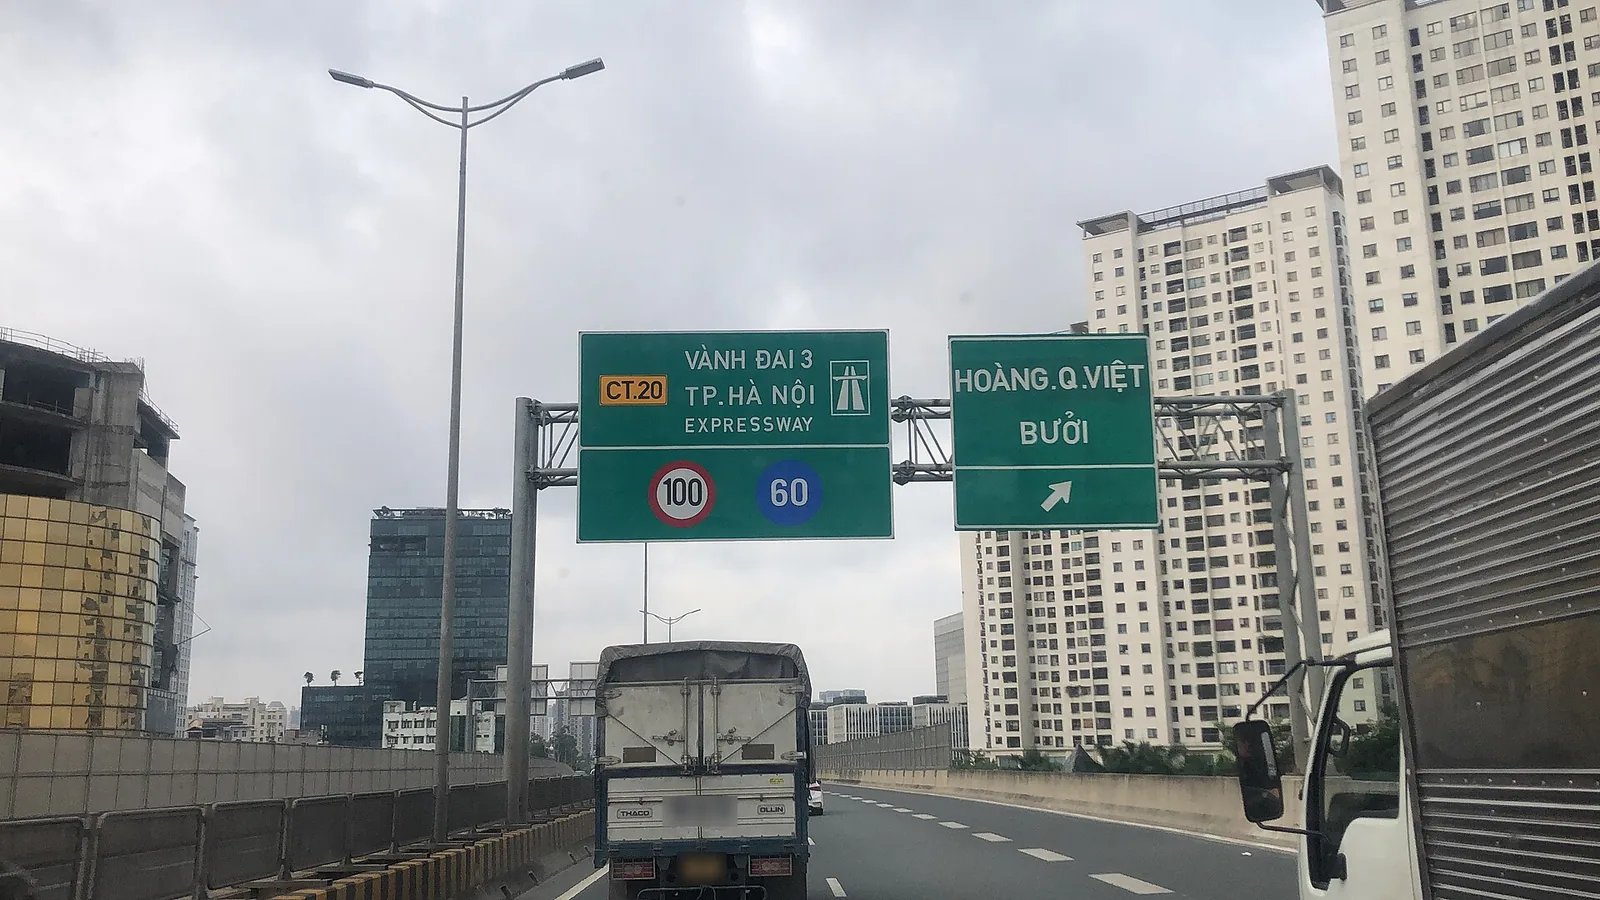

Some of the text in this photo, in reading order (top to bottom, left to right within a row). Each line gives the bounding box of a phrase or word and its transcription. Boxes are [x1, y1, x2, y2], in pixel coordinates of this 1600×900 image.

[685, 344, 814, 370] VÀNH ĐAI 3
[606, 380, 663, 400] CT.20
[955, 359, 1145, 393] HOÀNG.Q.VIỆT
[685, 379, 815, 409] TP.HÀ NỘI
[685, 416, 814, 433] EXPRESSWAY
[1019, 410, 1089, 445] BƯỞI
[662, 477, 703, 507] 100
[770, 478, 809, 507] 60
